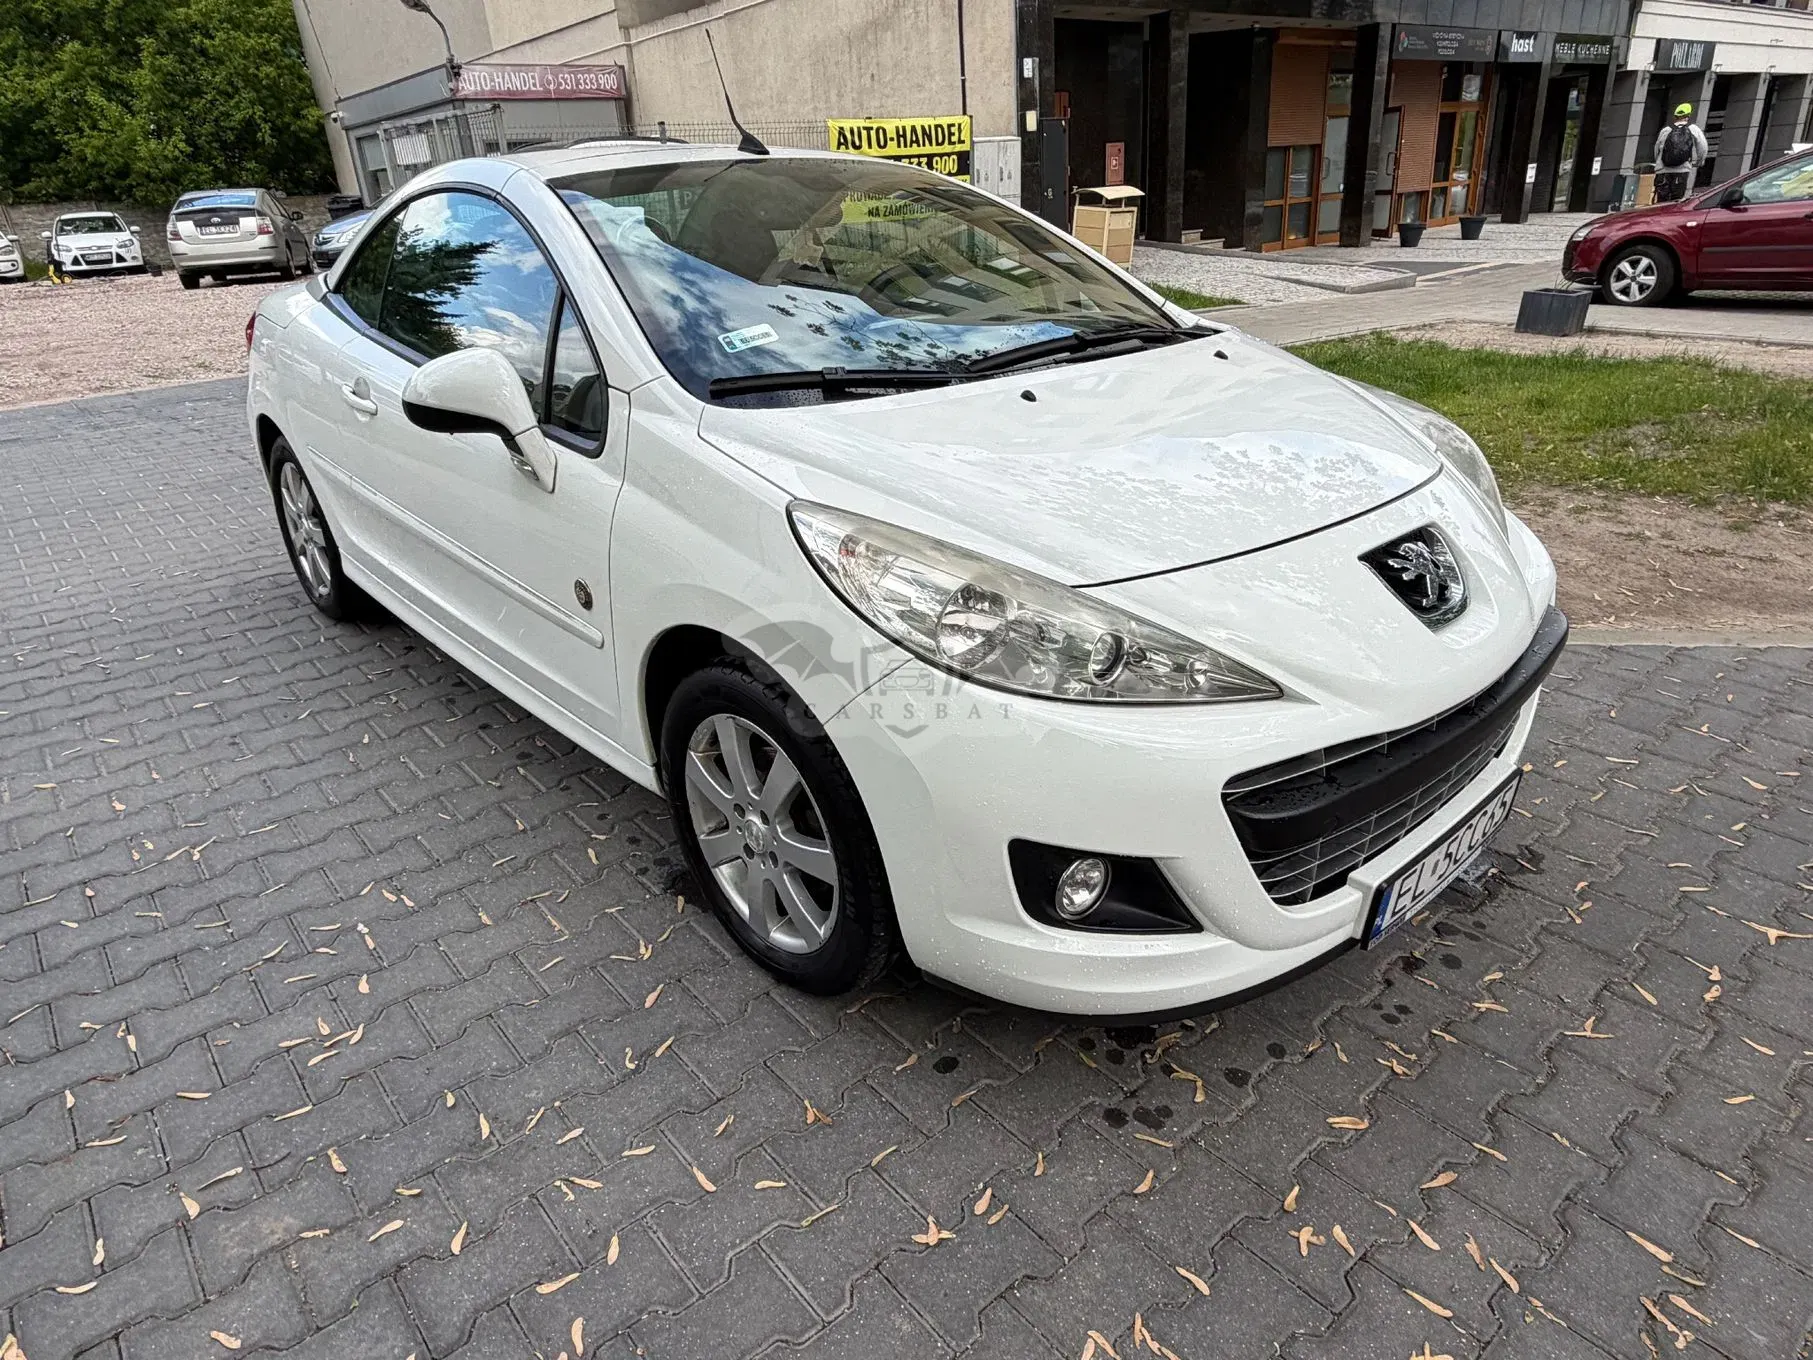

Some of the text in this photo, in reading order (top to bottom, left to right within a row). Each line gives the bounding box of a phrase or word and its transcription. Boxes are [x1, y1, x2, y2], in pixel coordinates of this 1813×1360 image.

[1511, 33, 1536, 53] hast
[1555, 43, 1610, 55] MEBLE KUCHENNE
[458, 72, 618, 91] AUTO-HANDEL 531 333 900
[836, 122, 966, 151] AUTO-HANDEL
[932, 155, 958, 174] 900
[867, 205, 880, 217] NA
[1391, 861, 1427, 918] EL
[1436, 783, 1514, 882] 5CC65
